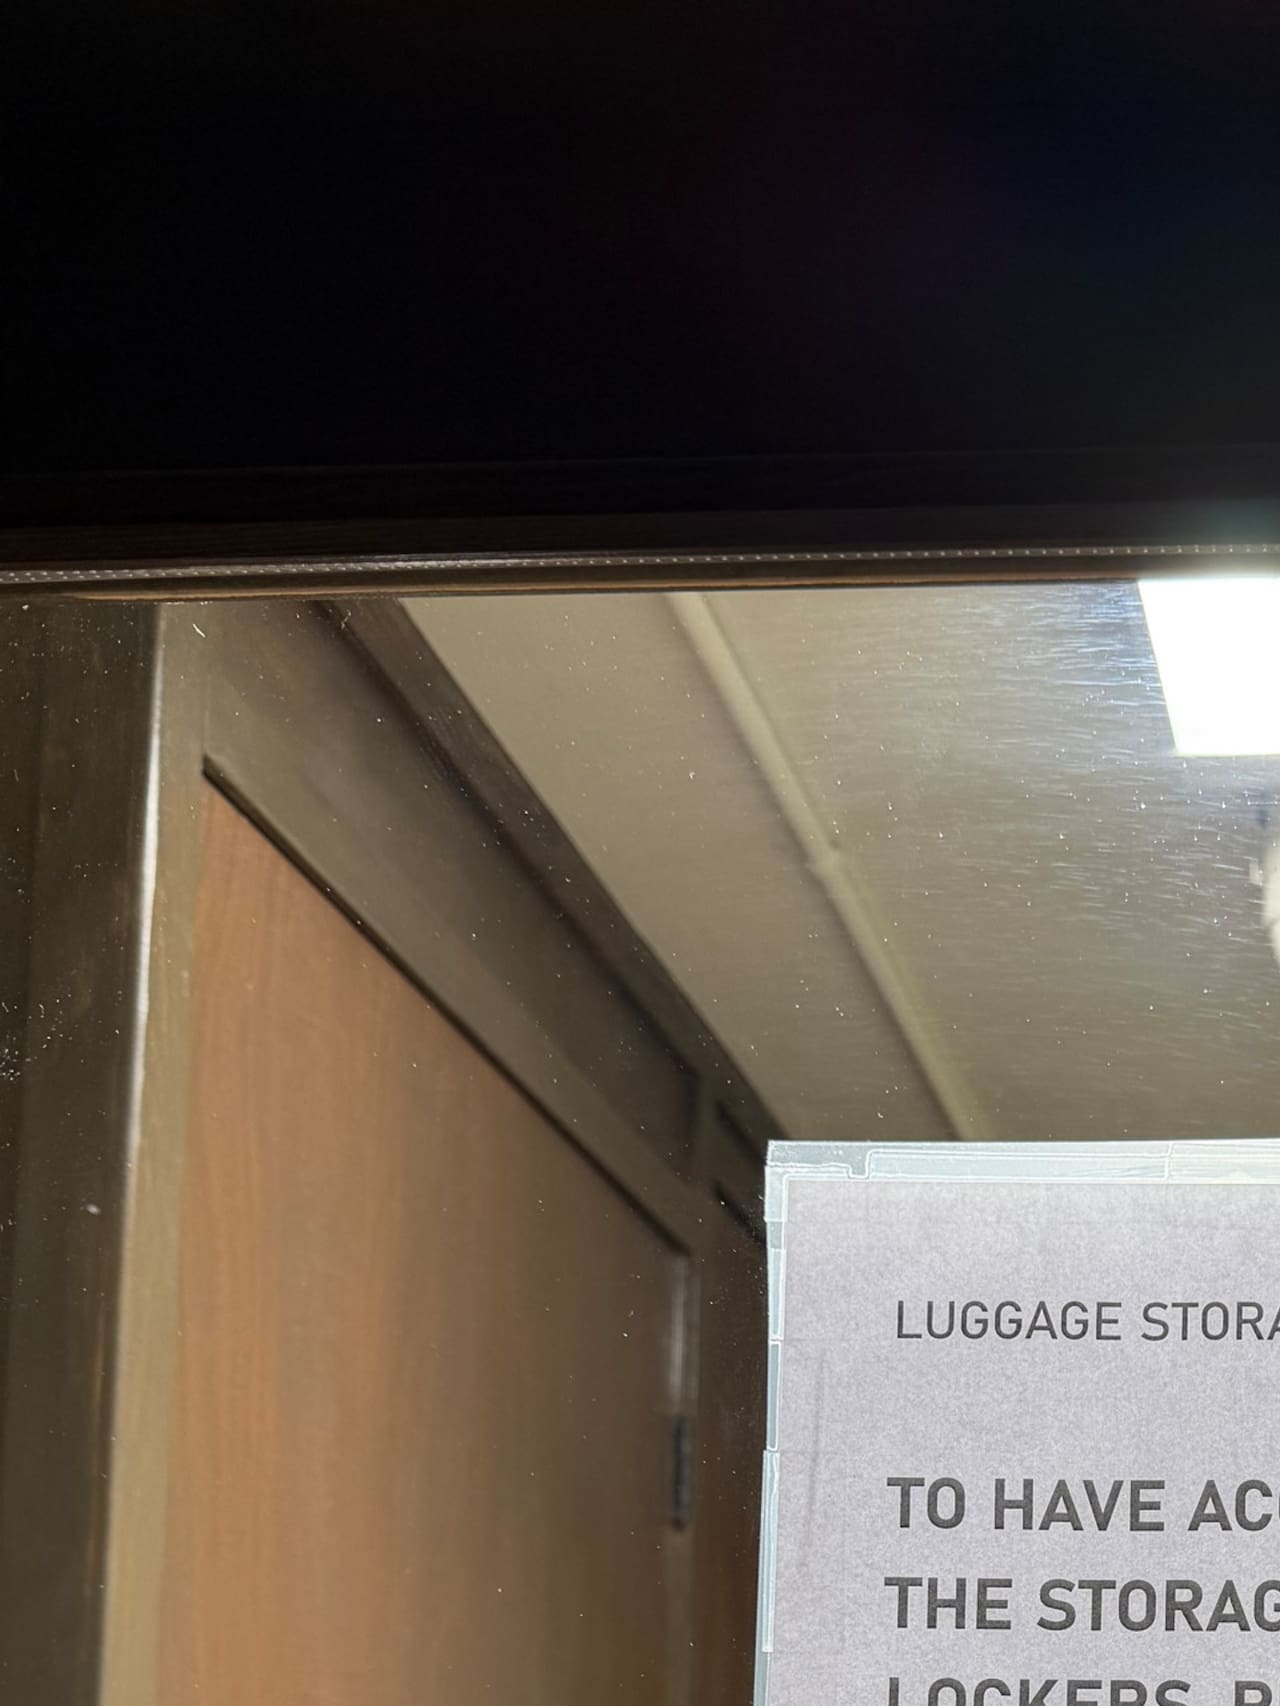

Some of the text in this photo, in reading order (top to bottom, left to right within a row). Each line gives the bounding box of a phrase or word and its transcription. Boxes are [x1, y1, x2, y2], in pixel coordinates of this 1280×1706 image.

[897, 1301, 1122, 1341] LUGGAGE
[887, 1477, 965, 1529] TO
[994, 1479, 1165, 1532] HAVE
[884, 1577, 1012, 1630] THE
